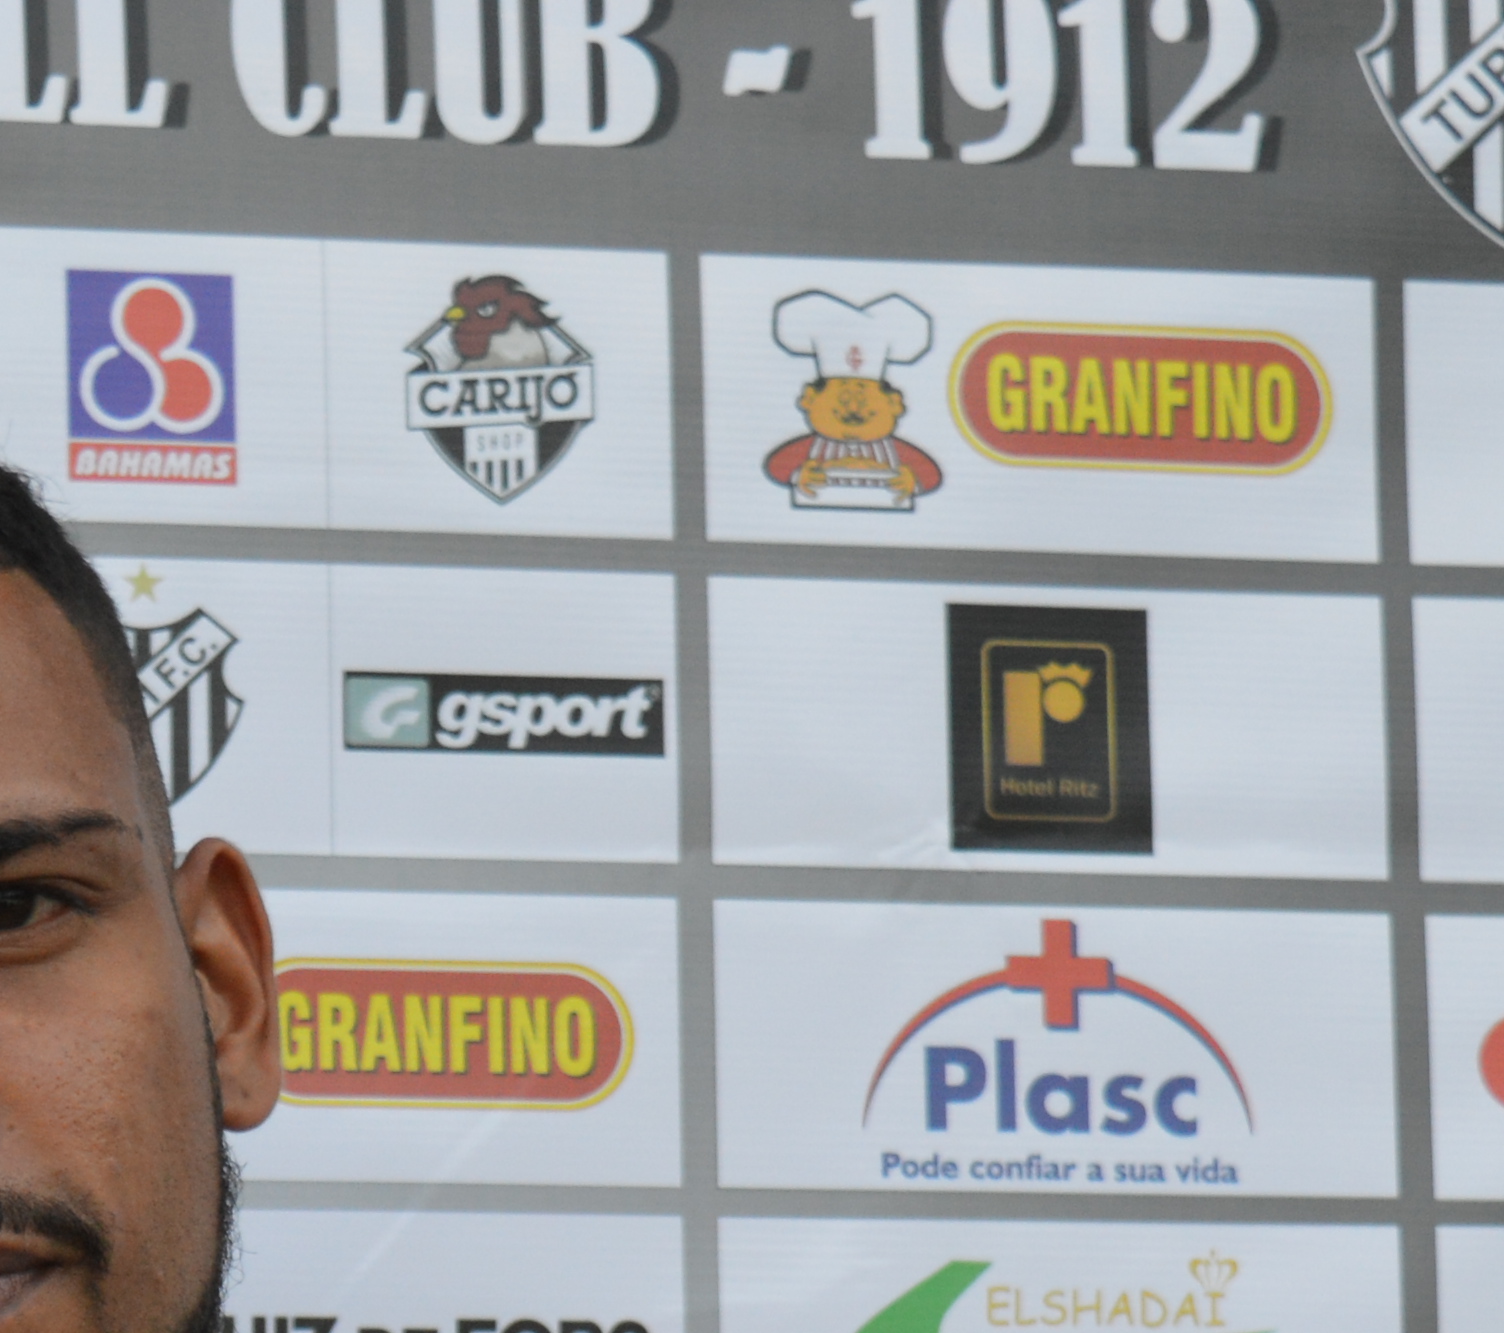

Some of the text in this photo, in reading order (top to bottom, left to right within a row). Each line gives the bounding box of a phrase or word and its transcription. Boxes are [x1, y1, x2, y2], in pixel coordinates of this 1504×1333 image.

[986, 351, 1299, 447] GRANFINO
[73, 445, 231, 481] BAHAMAS
[435, 686, 650, 748] gsport
[1000, 776, 1099, 798] Hotel Ritz
[277, 991, 596, 1077] GRANFINO
[924, 1038, 1198, 1137] Plasc
[881, 1151, 1239, 1184] Pode confiar a sua vida
